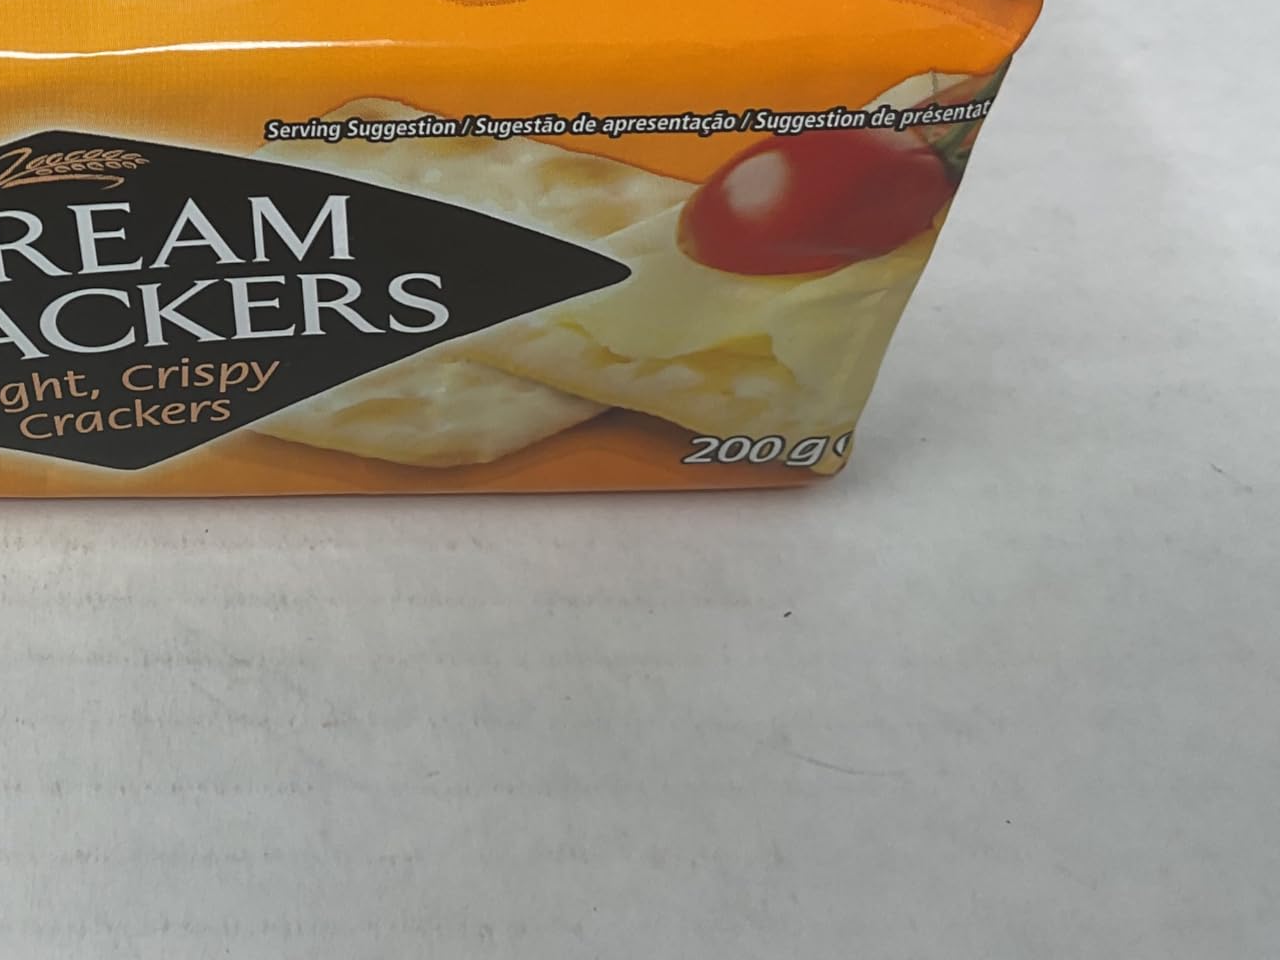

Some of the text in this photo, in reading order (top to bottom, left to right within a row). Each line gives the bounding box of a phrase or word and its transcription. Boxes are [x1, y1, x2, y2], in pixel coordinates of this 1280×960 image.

[268, 121, 341, 141] Serving
[347, 117, 456, 141] Suggestion
[475, 115, 566, 138] Sugestão
[572, 113, 597, 133] de
[602, 112, 736, 137] apresentação
[755, 108, 865, 134] Suggestion
[870, 107, 896, 127] de
[120, 356, 280, 393] Crispy
[19, 396, 232, 440] Crackers
[682, 436, 784, 464] 200
[784, 437, 828, 467] g
